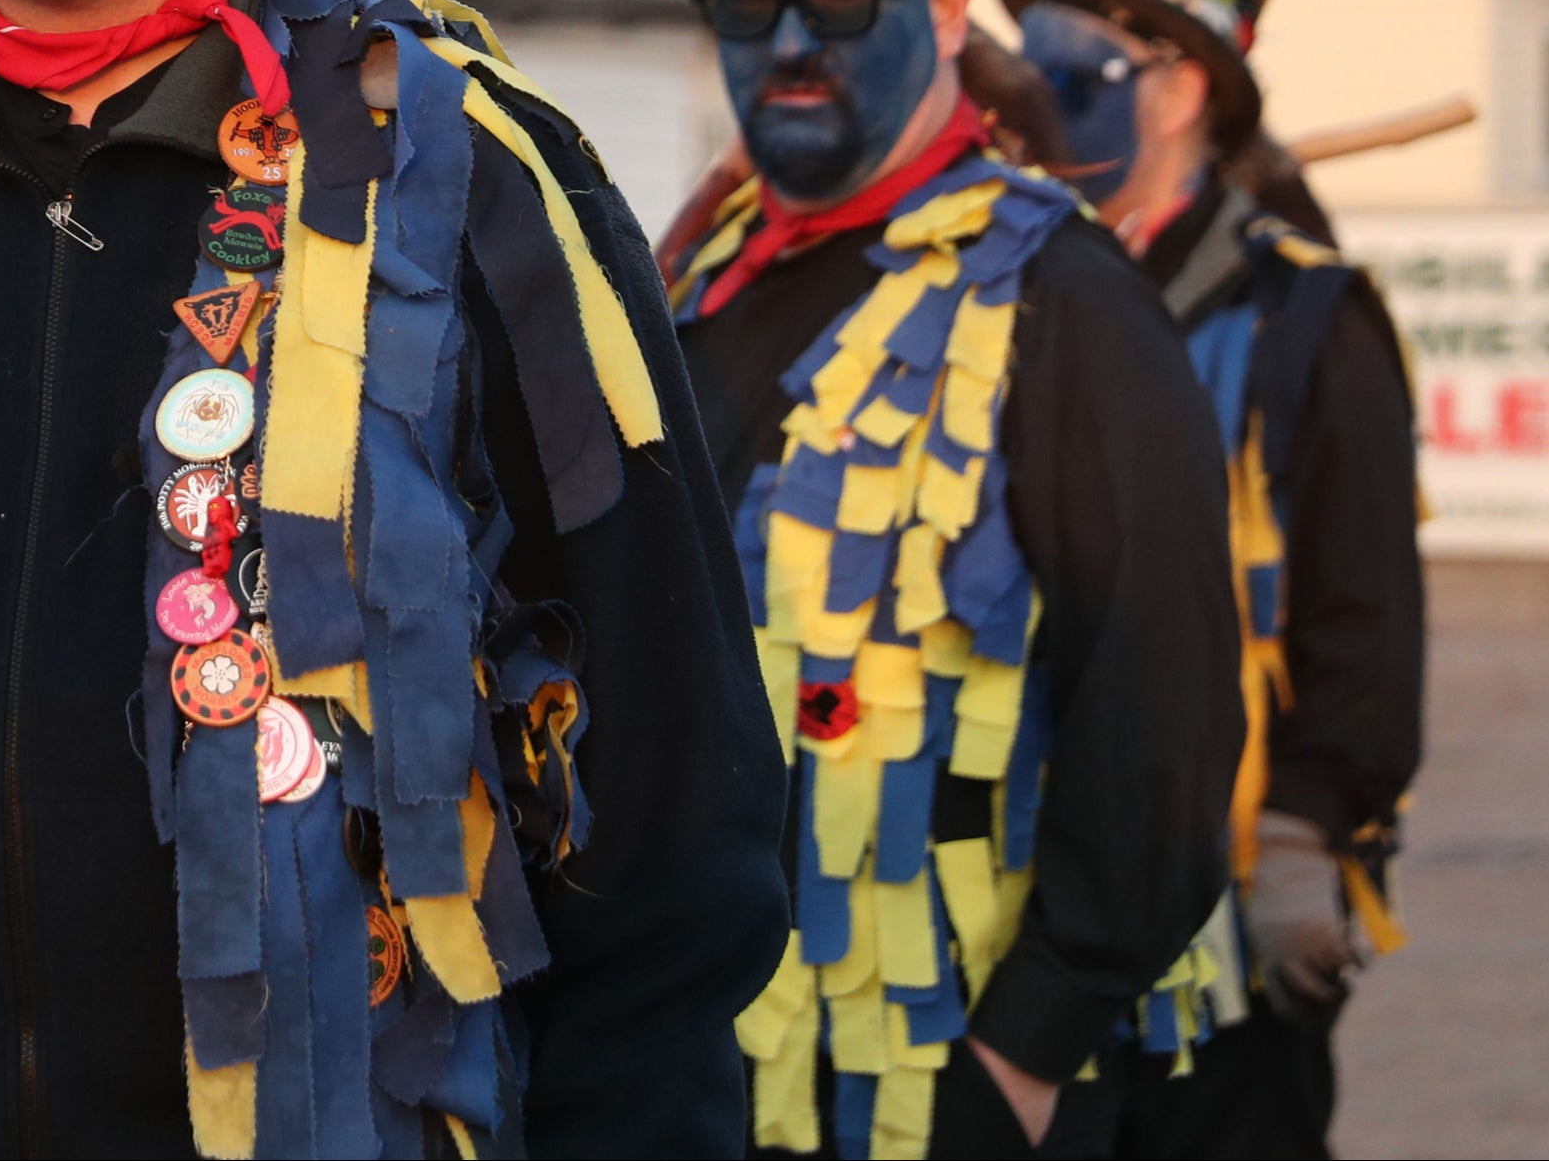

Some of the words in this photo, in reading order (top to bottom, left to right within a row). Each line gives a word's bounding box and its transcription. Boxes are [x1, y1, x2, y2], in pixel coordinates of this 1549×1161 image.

[262, 166, 282, 180] 25
[208, 241, 271, 265] Cookley
[157, 476, 175, 511] POTTY
